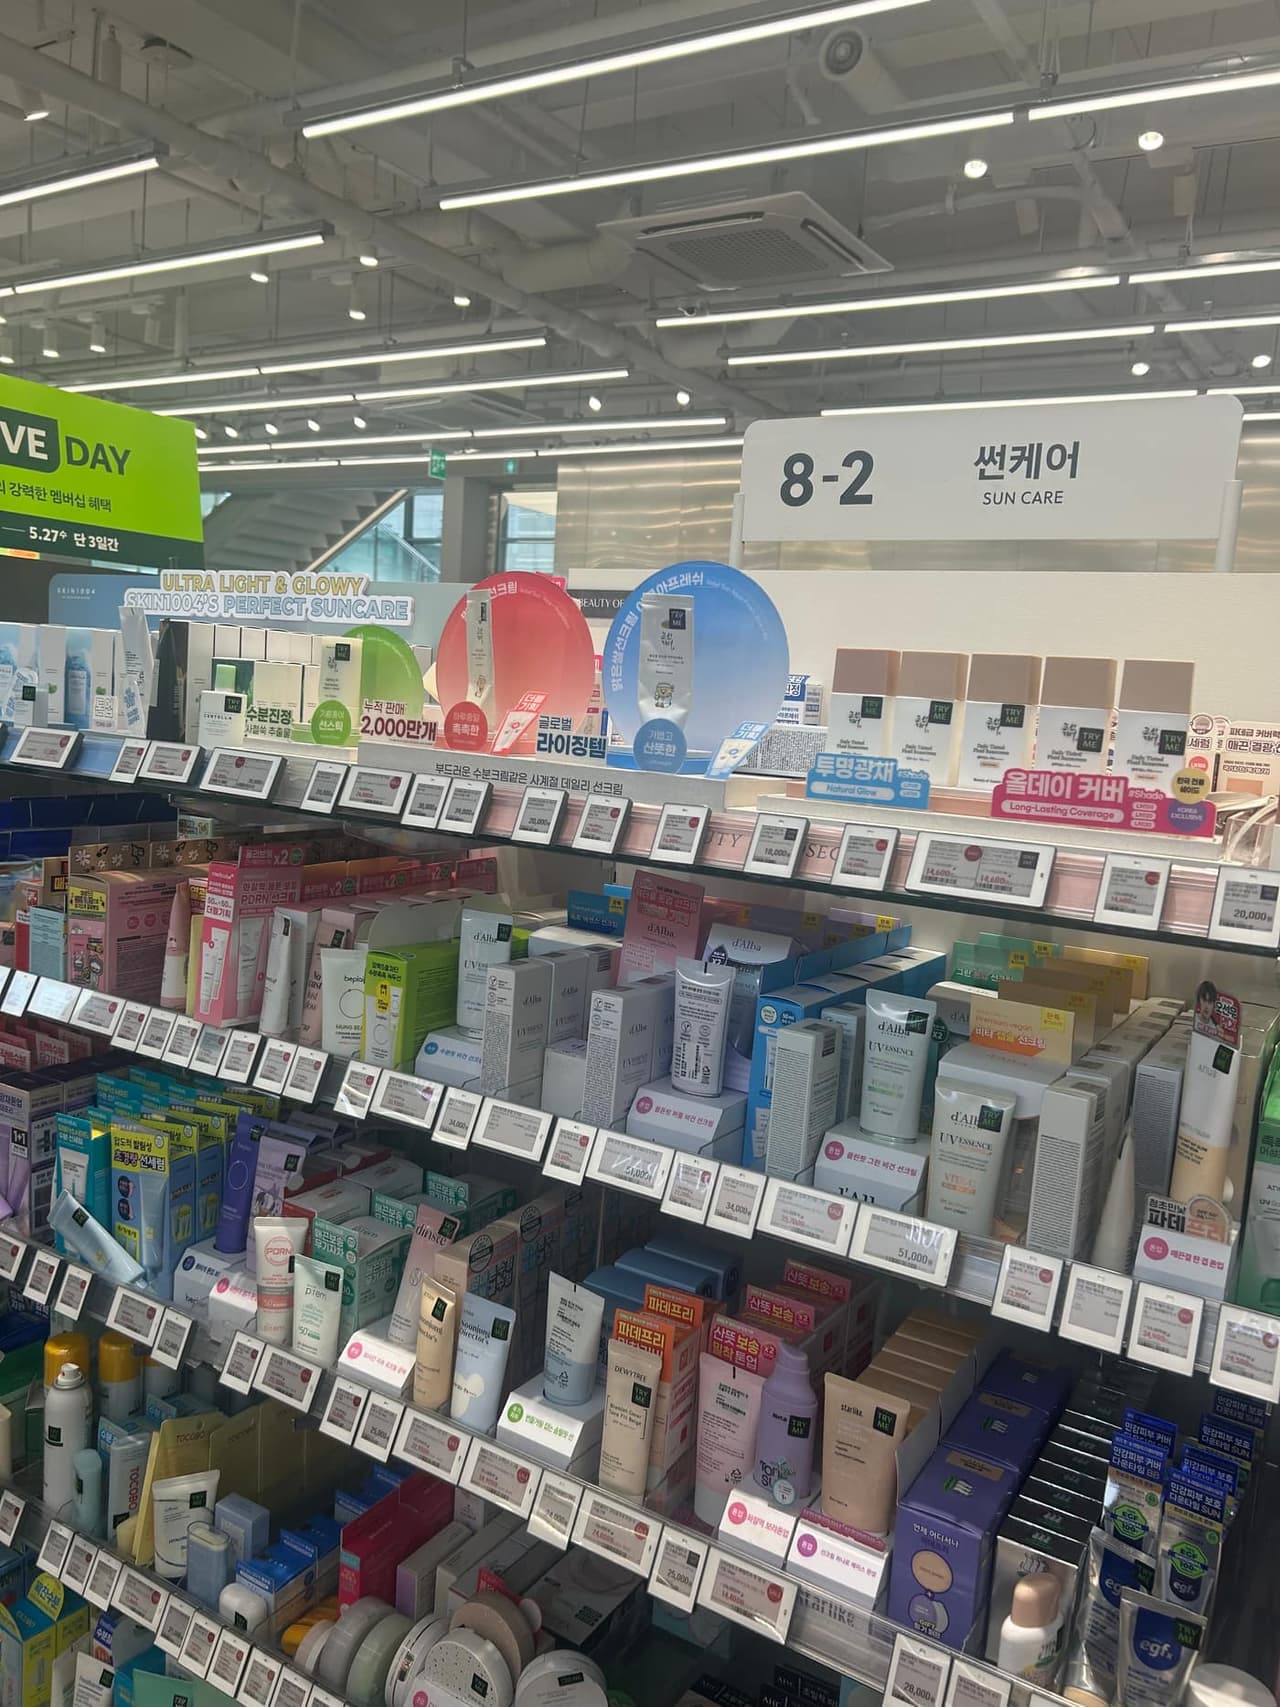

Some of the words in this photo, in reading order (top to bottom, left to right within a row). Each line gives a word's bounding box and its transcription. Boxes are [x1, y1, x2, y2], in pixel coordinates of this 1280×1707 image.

[65, 435, 132, 476] DAY
[973, 441, 1080, 480] 썬케어
[780, 450, 874, 507] 8-2
[9, 482, 47, 502] 강력한
[50, 489, 86, 509] 멤버십
[89, 497, 112, 512] 혜택
[982, 491, 1016, 506] SUN
[1021, 490, 1064, 505] CARE
[74, 532, 86, 548] 단
[88, 534, 119, 552] 3일간
[163, 573, 217, 593] ULTRA
[219, 574, 271, 594] LIGHT
[275, 576, 288, 594] &
[292, 576, 364, 597] GLOWY
[127, 591, 219, 613] SKIN1004'S
[224, 594, 307, 617] PERFECT
[310, 598, 409, 620] SUNCARE
[246, 708, 293, 725] 수분진정
[364, 700, 383, 714] 누적
[385, 702, 406, 715] 판매
[933, 712, 946, 720] ME
[934, 704, 950, 712] TRY
[1005, 707, 1022, 716] TRY
[361, 715, 437, 742] 2,000만개
[538, 715, 572, 731] 글로벌
[1005, 715, 1019, 724] ME
[452, 723, 480, 736] 촉촉한
[1083, 731, 1100, 740] TRY
[1165, 734, 1183, 743] TRY
[1230, 727, 1254, 737] 파데급
[537, 733, 607, 759] 라이징템
[643, 741, 676, 757] 산뜻한
[1082, 740, 1097, 748] ME
[1165, 743, 1181, 752] ME
[816, 754, 895, 784] 투명광채
[435, 763, 471, 776] 부드러운
[473, 766, 528, 785] 수분크림같은
[530, 773, 559, 789] 사계절
[561, 777, 591, 791] 데일리
[593, 780, 624, 795] 선크림
[1005, 770, 1072, 800] 올데이
[1078, 776, 1125, 804] 커버
[826, 784, 856, 795] Natural
[856, 786, 878, 797] Glow
[1009, 802, 1067, 818] Long-Lasting
[1069, 807, 1115, 821] Coverage
[647, 923, 675, 938] d'Alba
[731, 937, 762, 952] d'Alba
[878, 1021, 910, 1037] d'Alba
[975, 1026, 994, 1039] 비타
[1018, 1032, 1046, 1049] 선크림
[12, 1129, 27, 1146] 1+1
[113, 1136, 132, 1148] 압도적
[133, 1139, 152, 1153] 발림성
[140, 1154, 166, 1172] 선세럼
[897, 1162, 917, 1176] 선크림
[1148, 1209, 1186, 1233] 파데
[265, 1247, 293, 1256] PDRN
[787, 1270, 808, 1287] 산뜻
[809, 1277, 832, 1295] 보송
[648, 1296, 694, 1322] 파데프리
[750, 1296, 772, 1317] 산뜻
[772, 1305, 794, 1323] 보송
[618, 1320, 665, 1349] 파데프리
[713, 1326, 736, 1346] 산뜻
[737, 1332, 761, 1355] 보송
[712, 1340, 734, 1361] 밀착
[735, 1351, 758, 1370] 톤업
[614, 1365, 646, 1382] DEWYTREE
[792, 1419, 806, 1428] TRY
[877, 1421, 889, 1431] ME
[878, 1412, 893, 1423] TRY
[1124, 1422, 1155, 1440] 민감피부
[1156, 1432, 1172, 1445] 커버
[1202, 1426, 1234, 1443] 민감피부
[1234, 1436, 1251, 1449] 보호
[1201, 1434, 1231, 1451] 다운타임
[1231, 1445, 1250, 1458] SUN
[1113, 1446, 1144, 1462] 민감피부
[1146, 1457, 1162, 1471] 커버
[1112, 1456, 1146, 1474] 다운타임
[1147, 1469, 1161, 1480] BB
[1183, 1457, 1216, 1475] 민감피부
[1217, 1470, 1234, 1483] 보호
[128, 1467, 140, 1511] TOCOBO
[1170, 1481, 1204, 1501] 민감피부
[1205, 1497, 1222, 1510] 보호
[1169, 1492, 1200, 1510] 다운타임
[1200, 1504, 1221, 1519] SUN
[1121, 1511, 1138, 1522] EGF
[1180, 1550, 1198, 1560] EGF
[1178, 1624, 1198, 1636] TRY
